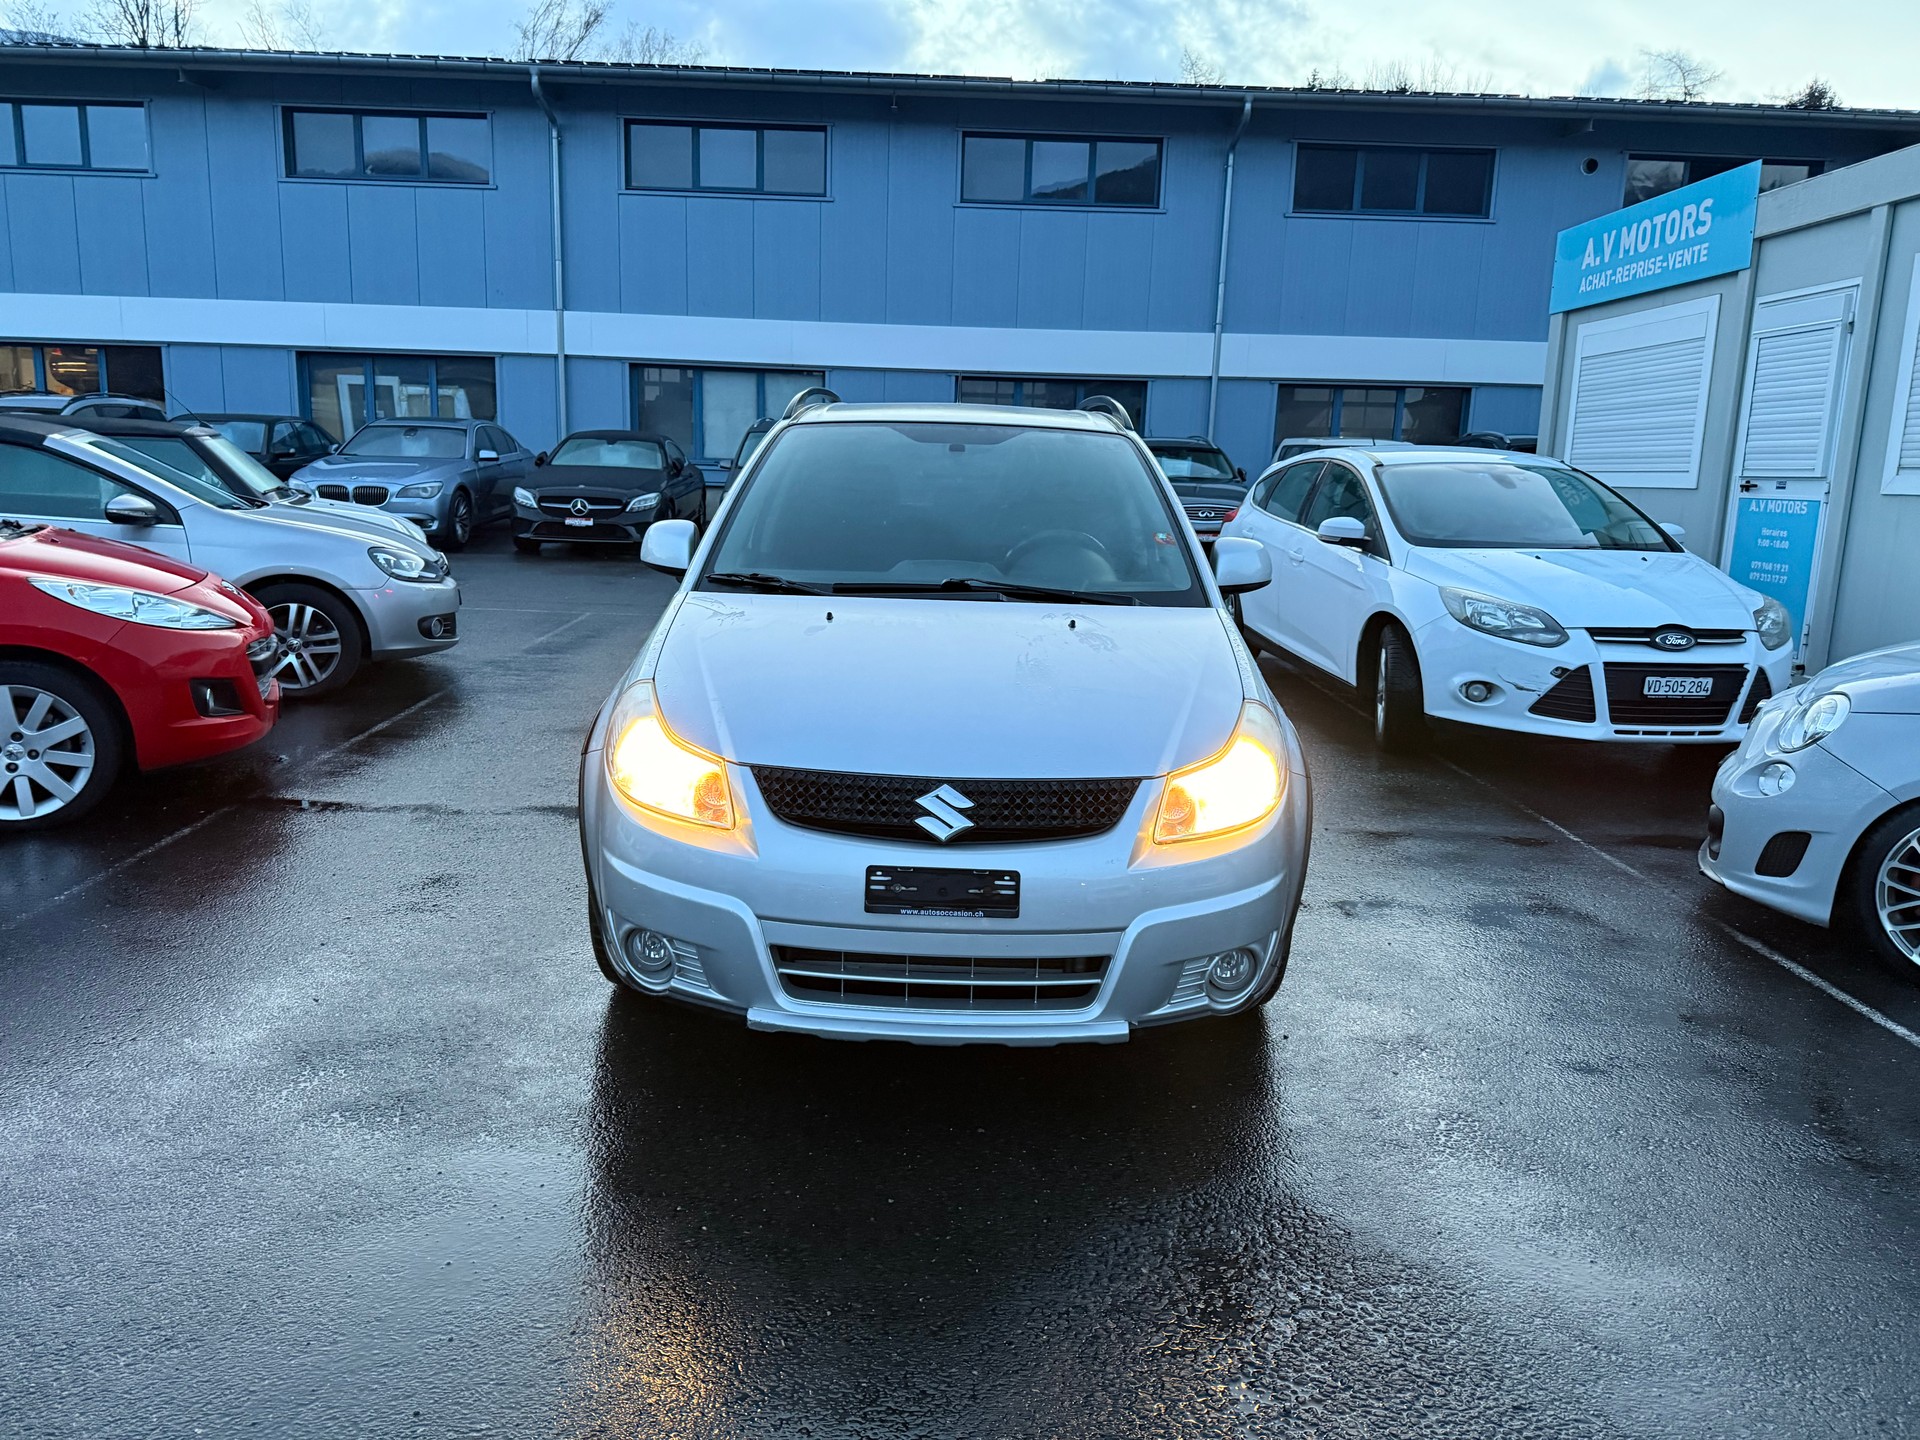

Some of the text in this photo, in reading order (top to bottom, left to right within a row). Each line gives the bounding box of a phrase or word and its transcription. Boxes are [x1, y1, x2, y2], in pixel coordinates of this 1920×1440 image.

[1581, 197, 1714, 270] A.V MOTORS
[1579, 242, 1710, 294] ACHAT-REPRISE-VENTE
[1749, 499, 1808, 514] A.V MOTORS
[1761, 527, 1788, 538] Horaires
[1665, 634, 1688, 645] Ford
[900, 908, 984, 918] www.autosoccasion.ch
